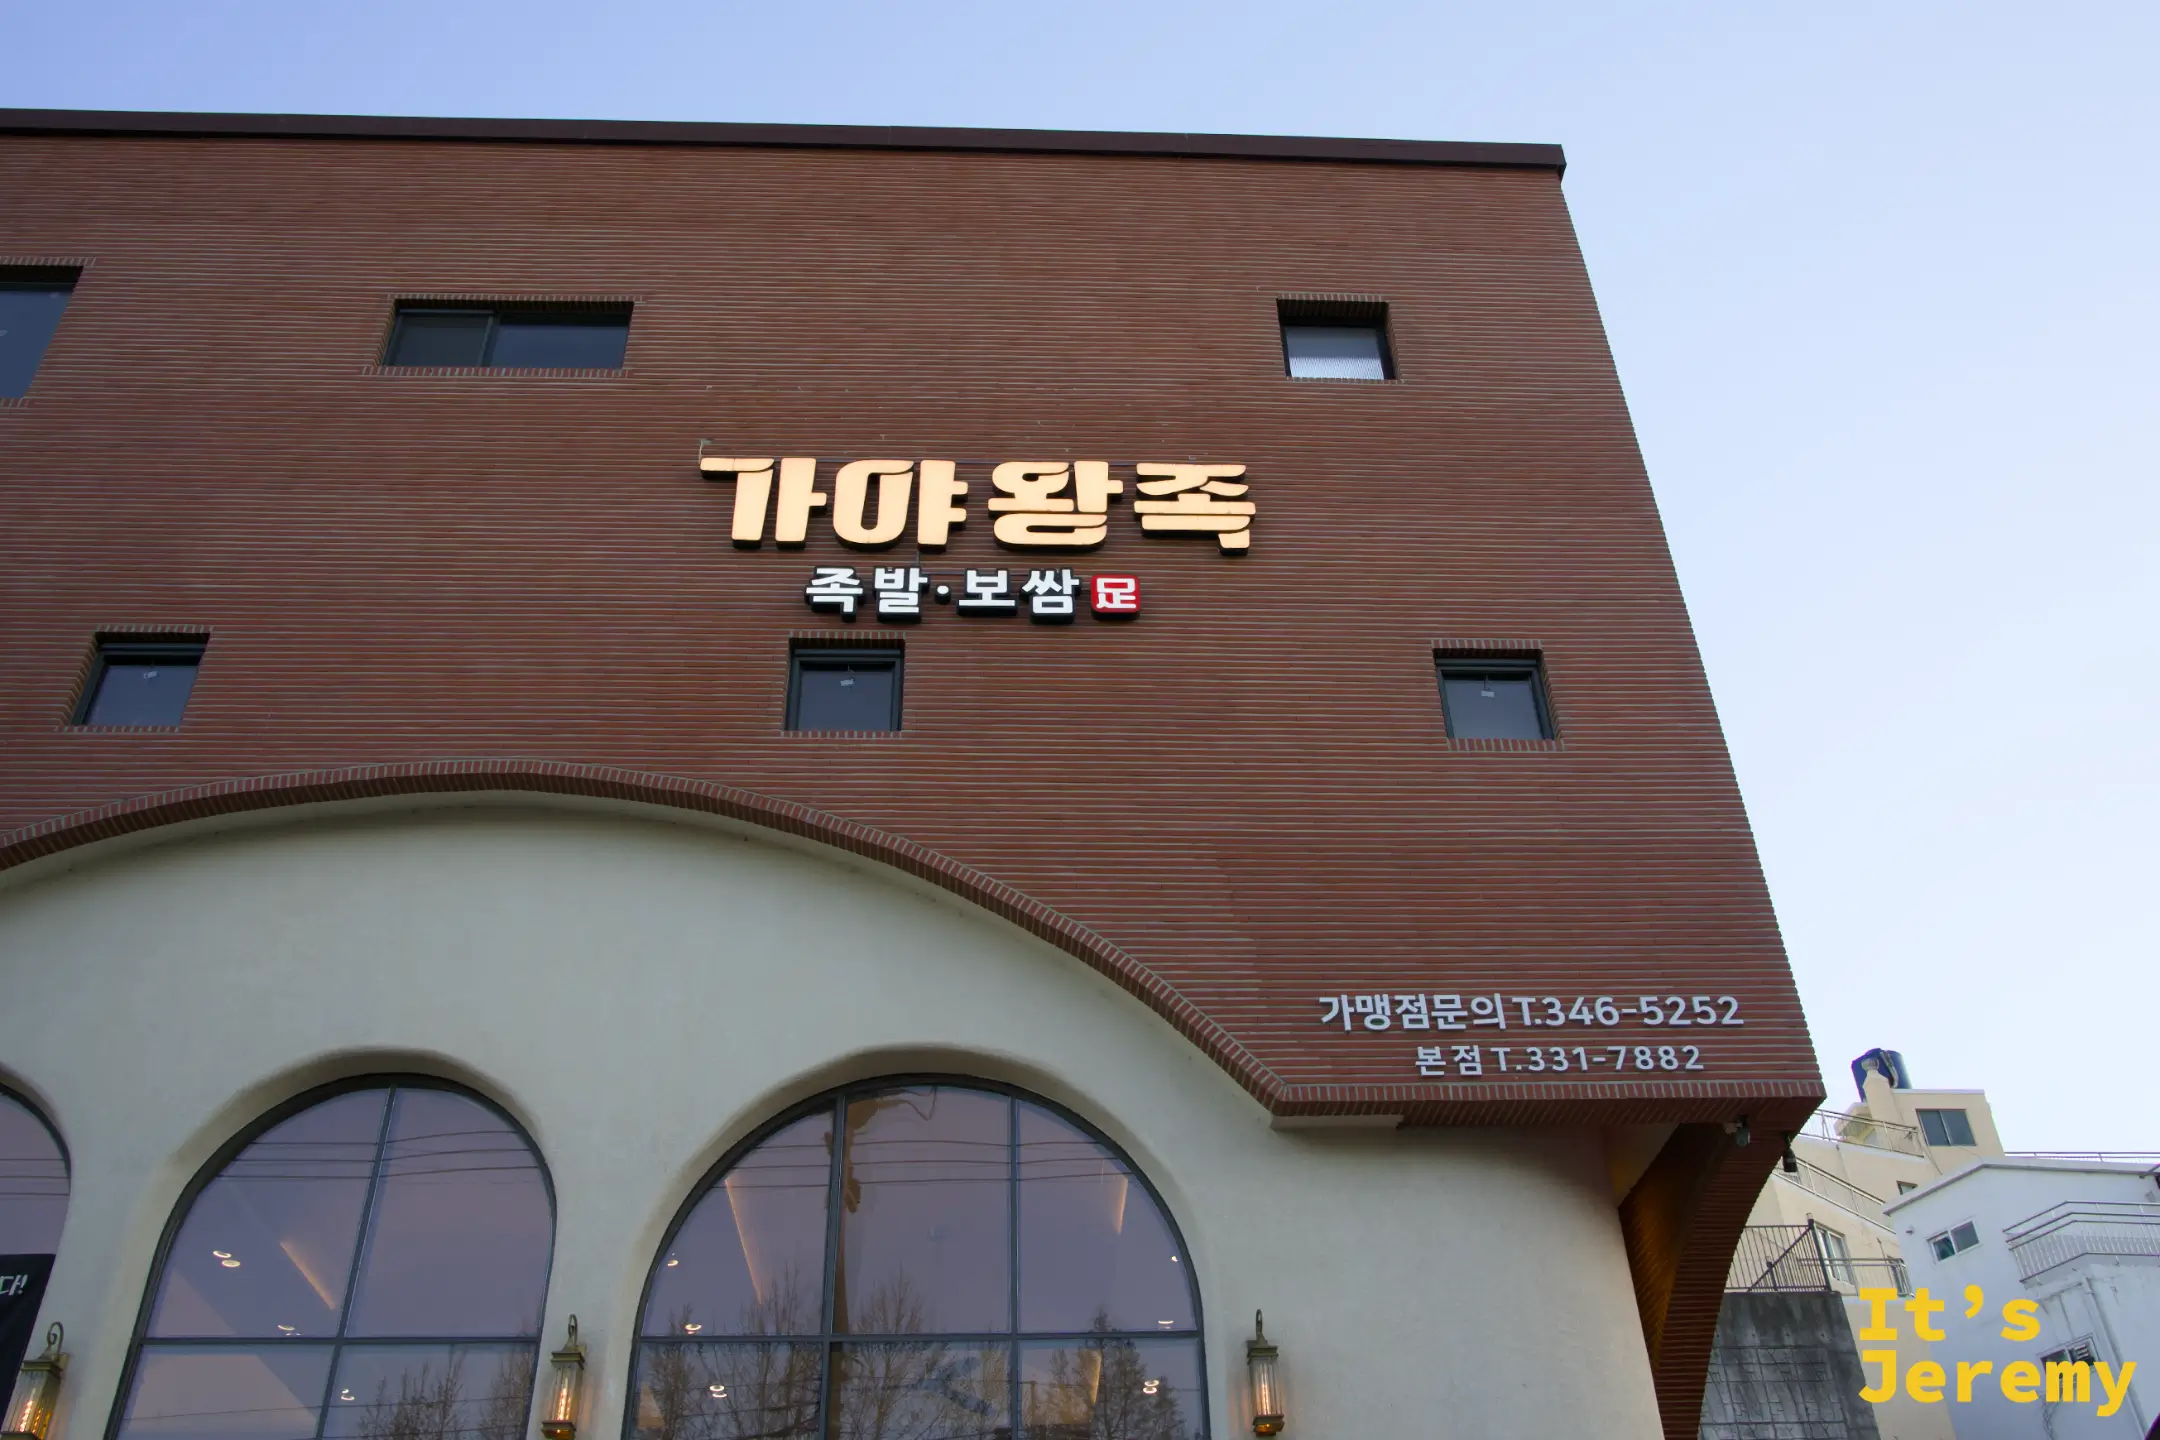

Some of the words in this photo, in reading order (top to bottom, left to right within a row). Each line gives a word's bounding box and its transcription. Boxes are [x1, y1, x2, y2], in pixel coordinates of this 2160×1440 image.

[700, 457, 1256, 555] 가야왕족
[1319, 993, 1506, 1031] 가맹점문의
[1512, 996, 1744, 1027] T.346-5252
[1490, 1045, 1704, 1072] T.331-7882
